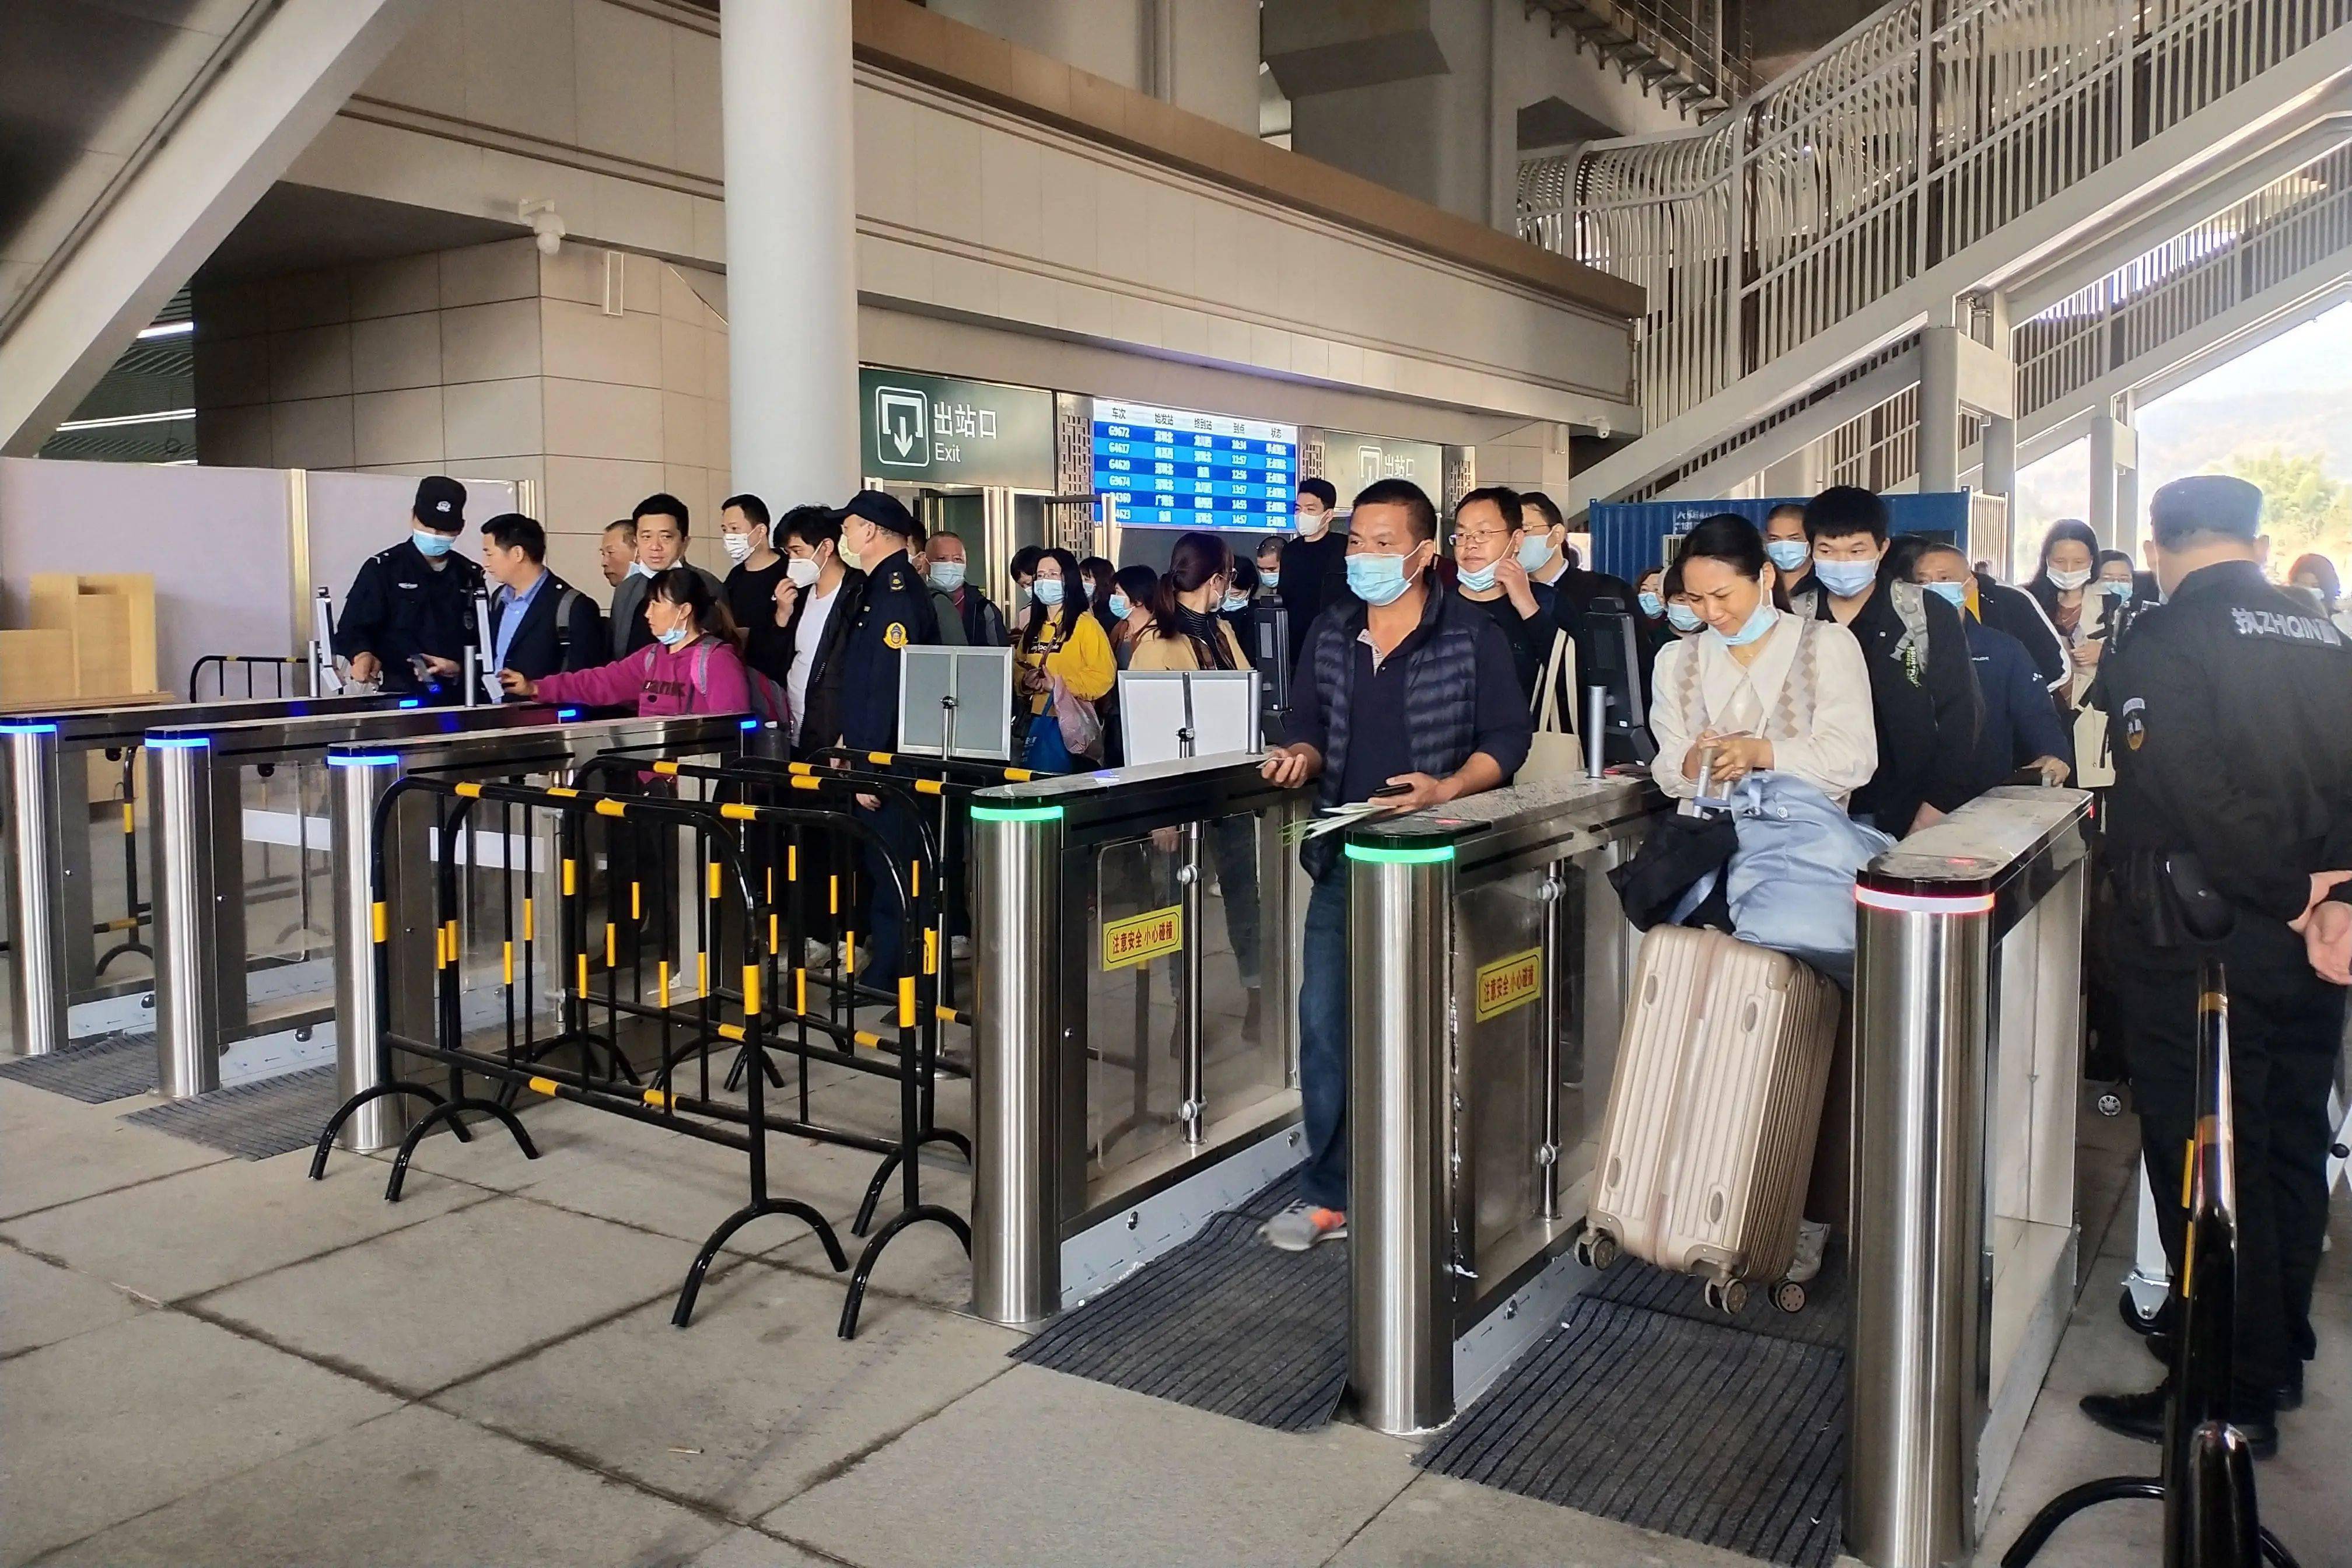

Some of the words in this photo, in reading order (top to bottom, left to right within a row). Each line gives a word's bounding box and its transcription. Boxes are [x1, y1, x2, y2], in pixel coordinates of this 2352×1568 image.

[934, 401, 997, 439] 出站口
[1112, 407, 1126, 419] 车次
[1154, 413, 1174, 426] 始发站
[1194, 418, 1212, 430] 终到站
[935, 443, 961, 463] Exit
[1384, 453, 1415, 478] 出站口
[1112, 928, 1142, 954] 注意安全
